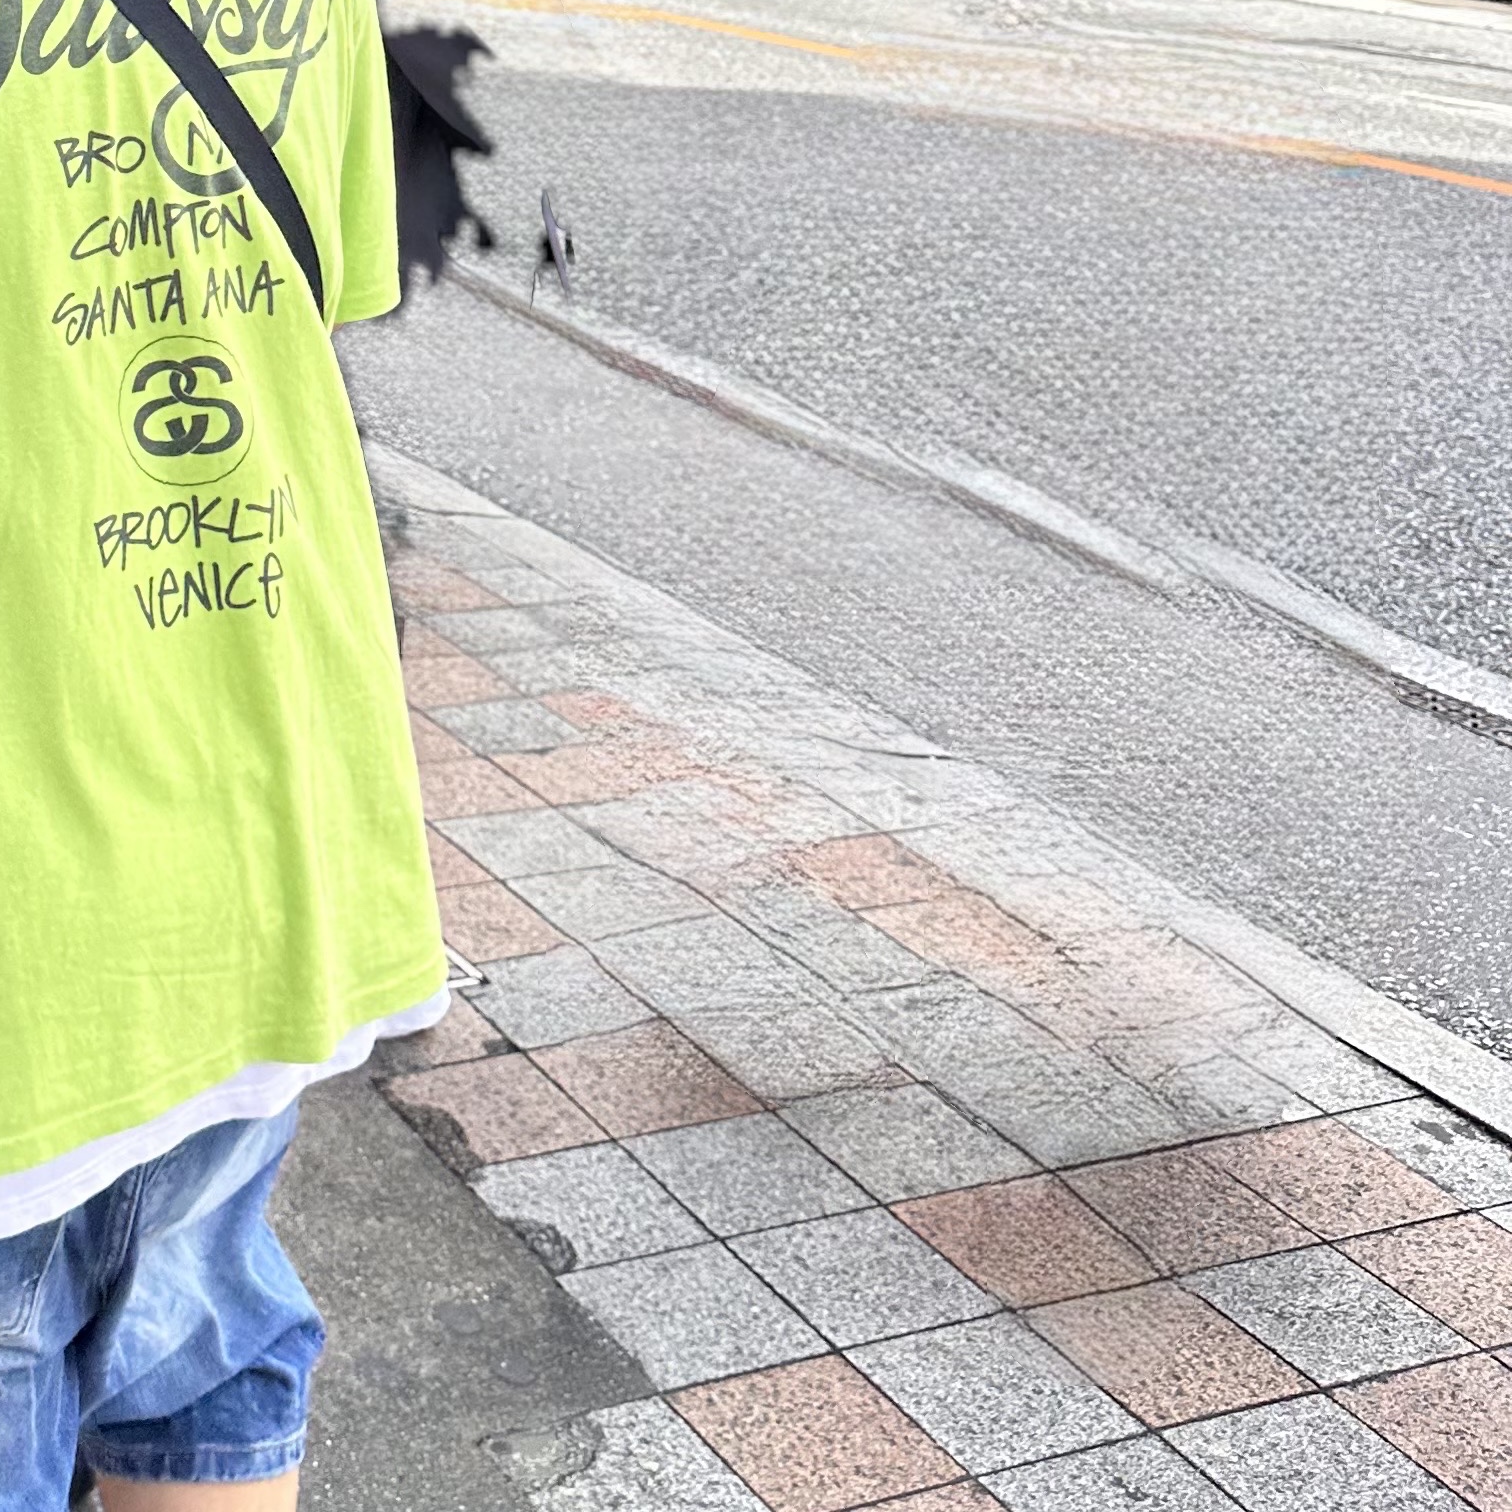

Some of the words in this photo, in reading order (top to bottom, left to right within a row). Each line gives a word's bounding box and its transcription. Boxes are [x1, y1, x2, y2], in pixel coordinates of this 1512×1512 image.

[70, 194, 253, 260] COMPTON
[52, 268, 187, 346] SANTA
[201, 260, 285, 319] ANA
[94, 474, 302, 571] BROOKLYN
